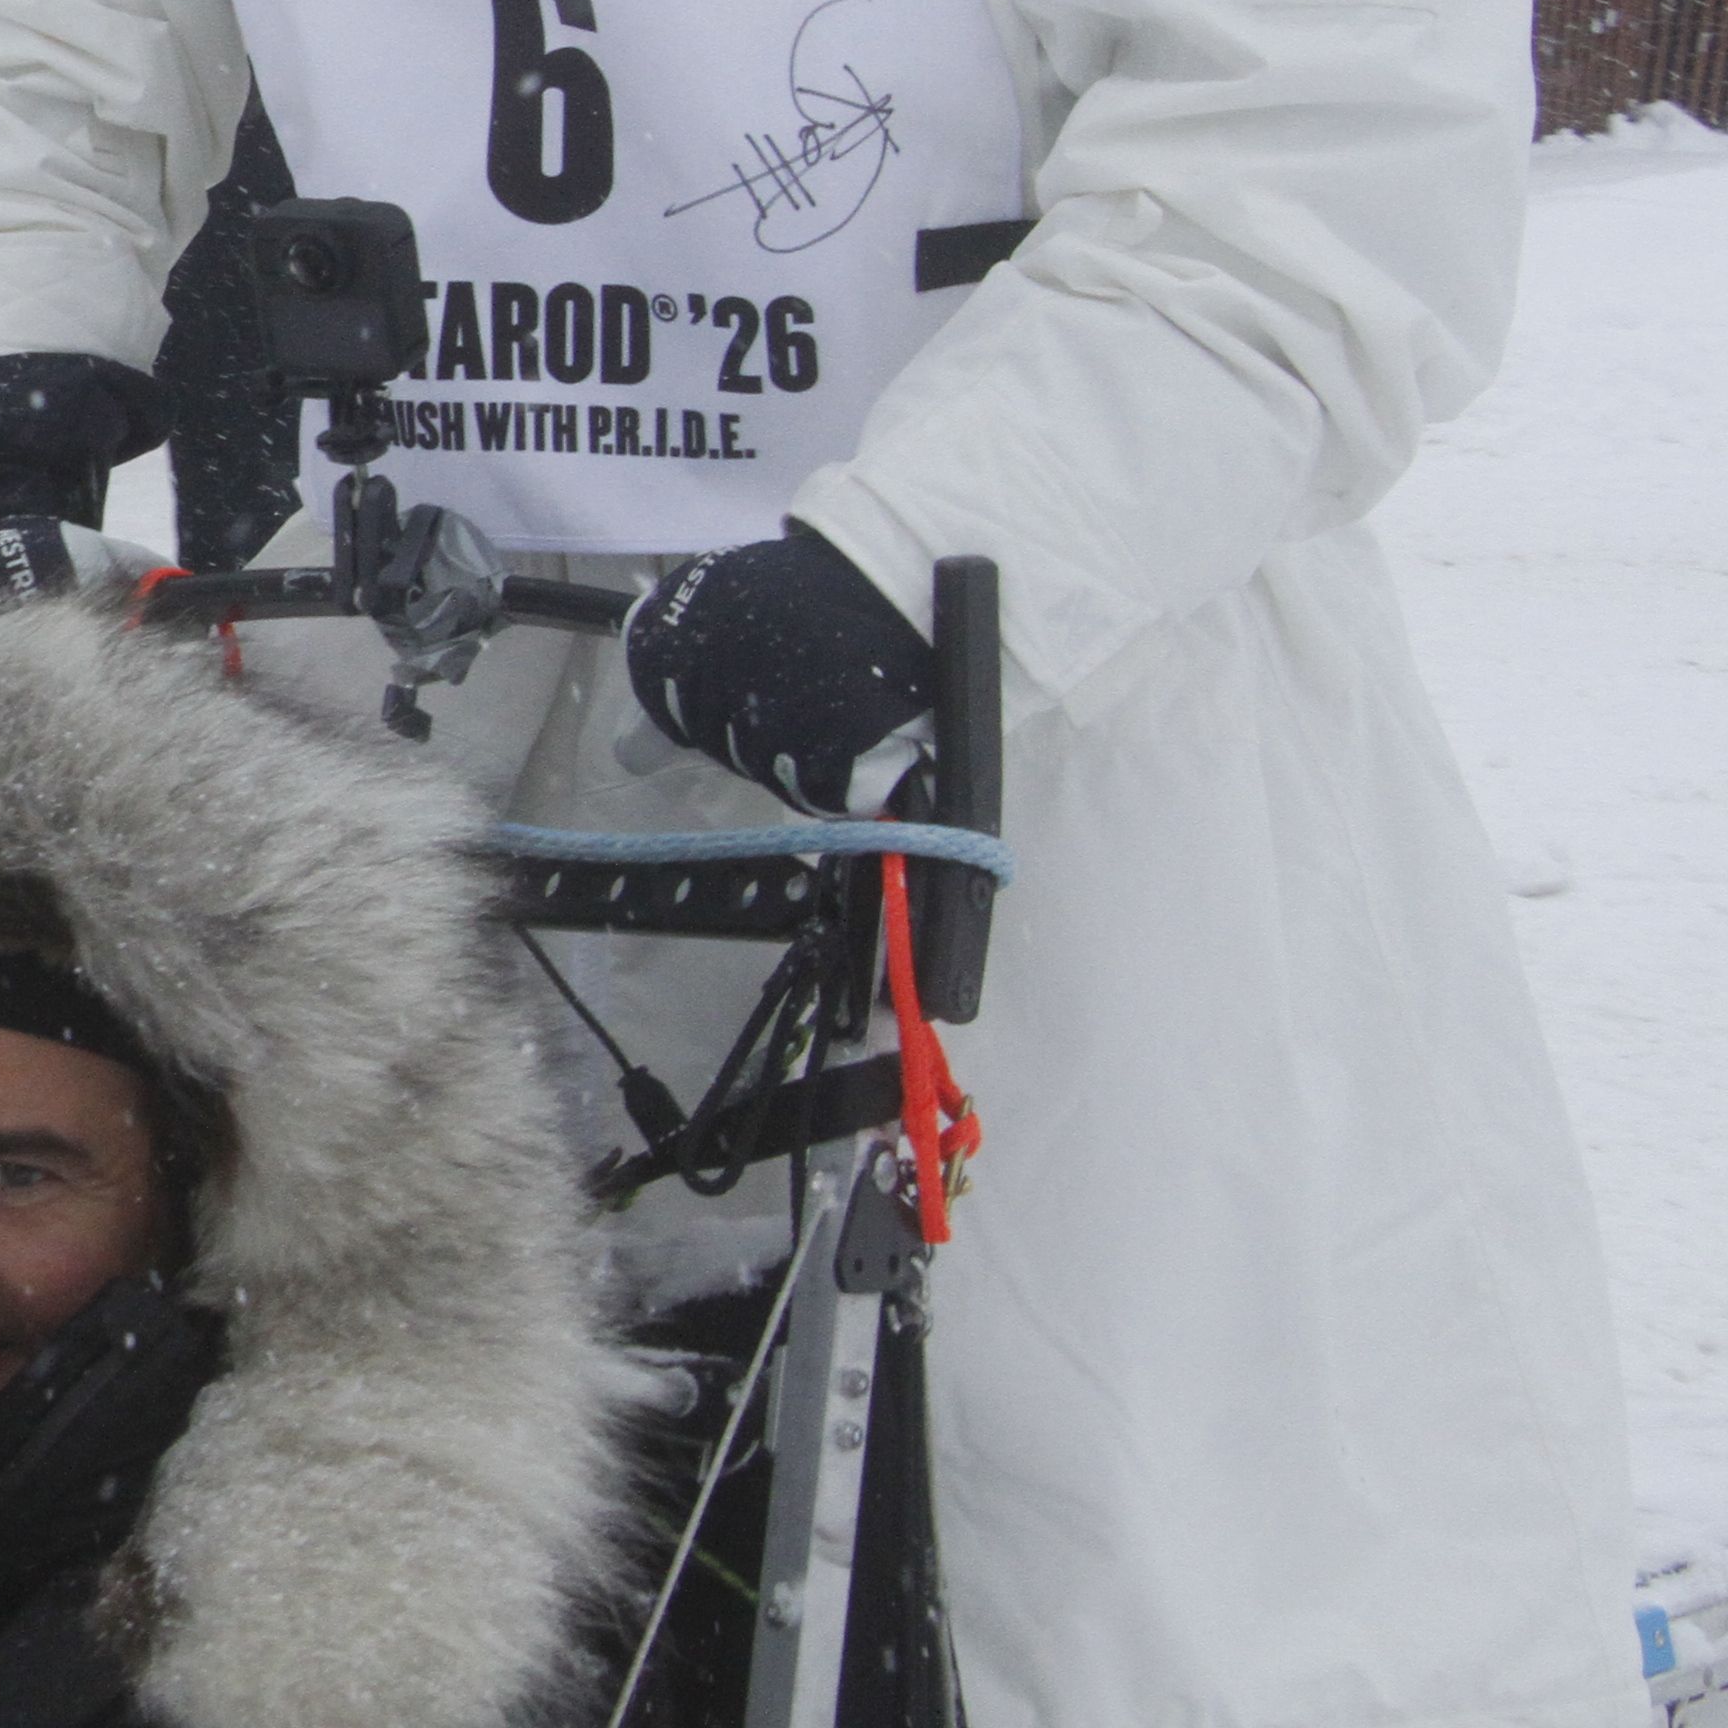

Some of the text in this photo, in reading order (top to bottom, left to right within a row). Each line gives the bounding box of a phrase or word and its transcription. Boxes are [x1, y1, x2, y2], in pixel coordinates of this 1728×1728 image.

[382, 398, 757, 460] USH WITH P.R.I.D.E.
